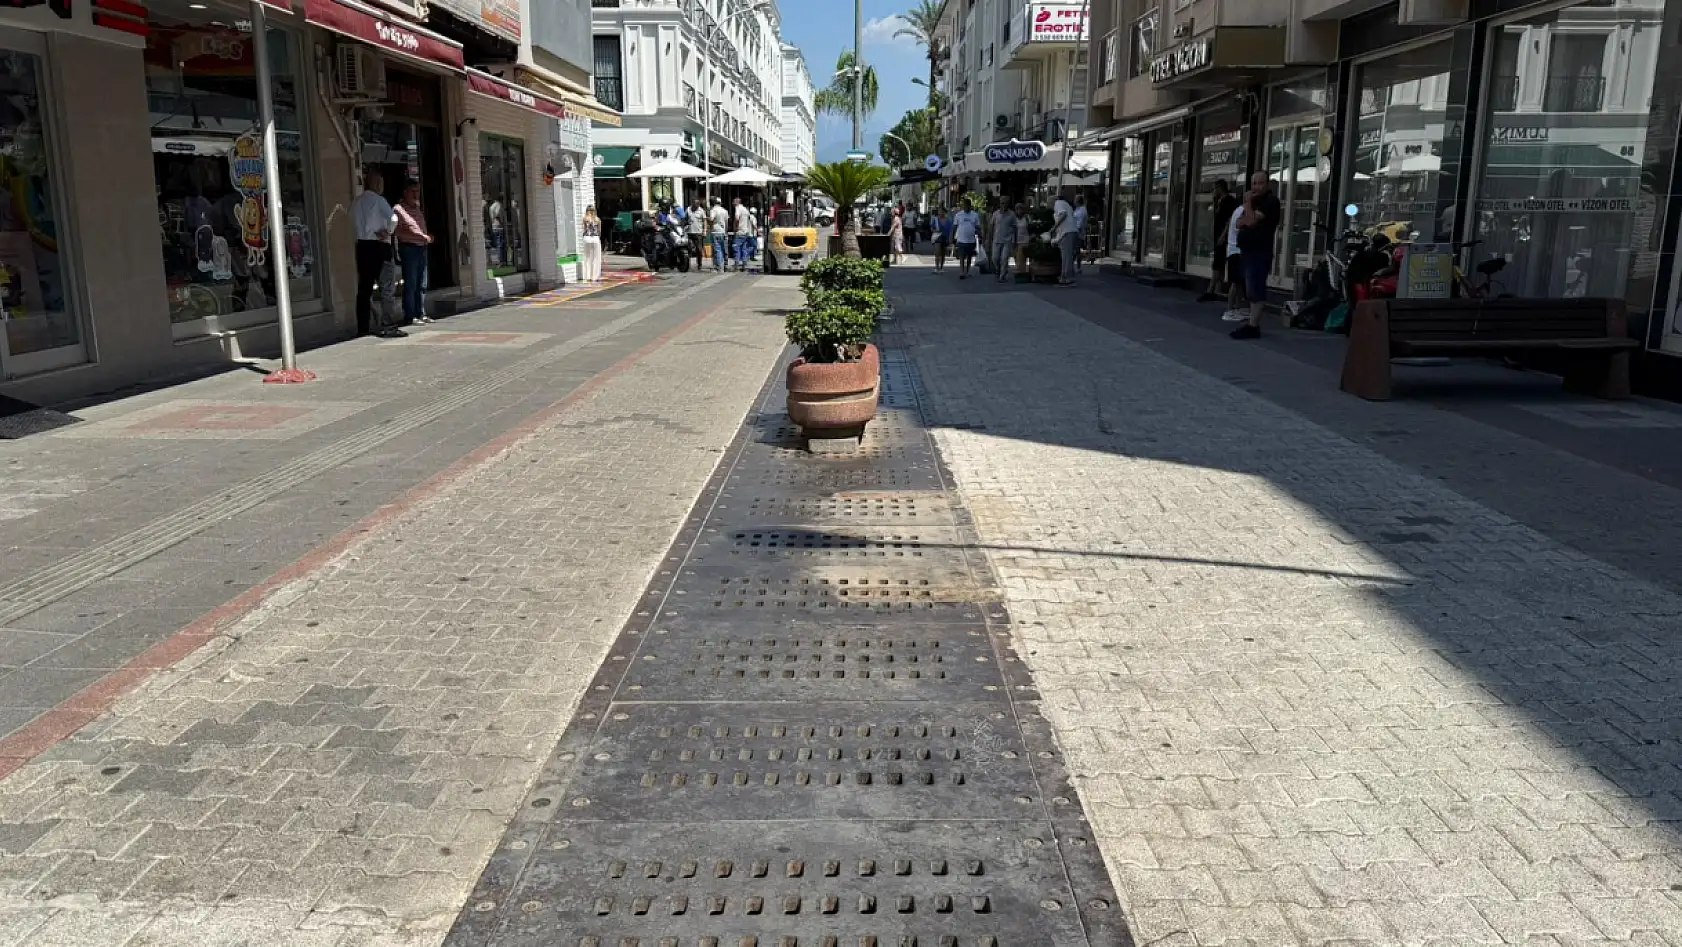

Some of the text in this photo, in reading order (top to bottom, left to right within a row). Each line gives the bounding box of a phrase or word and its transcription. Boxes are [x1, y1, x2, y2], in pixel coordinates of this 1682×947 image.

[1057, 10, 1091, 18] FET
[1035, 22, 1085, 33] EROTİK
[988, 147, 1038, 160] CINNABON
[1609, 200, 1631, 210] OTEL
